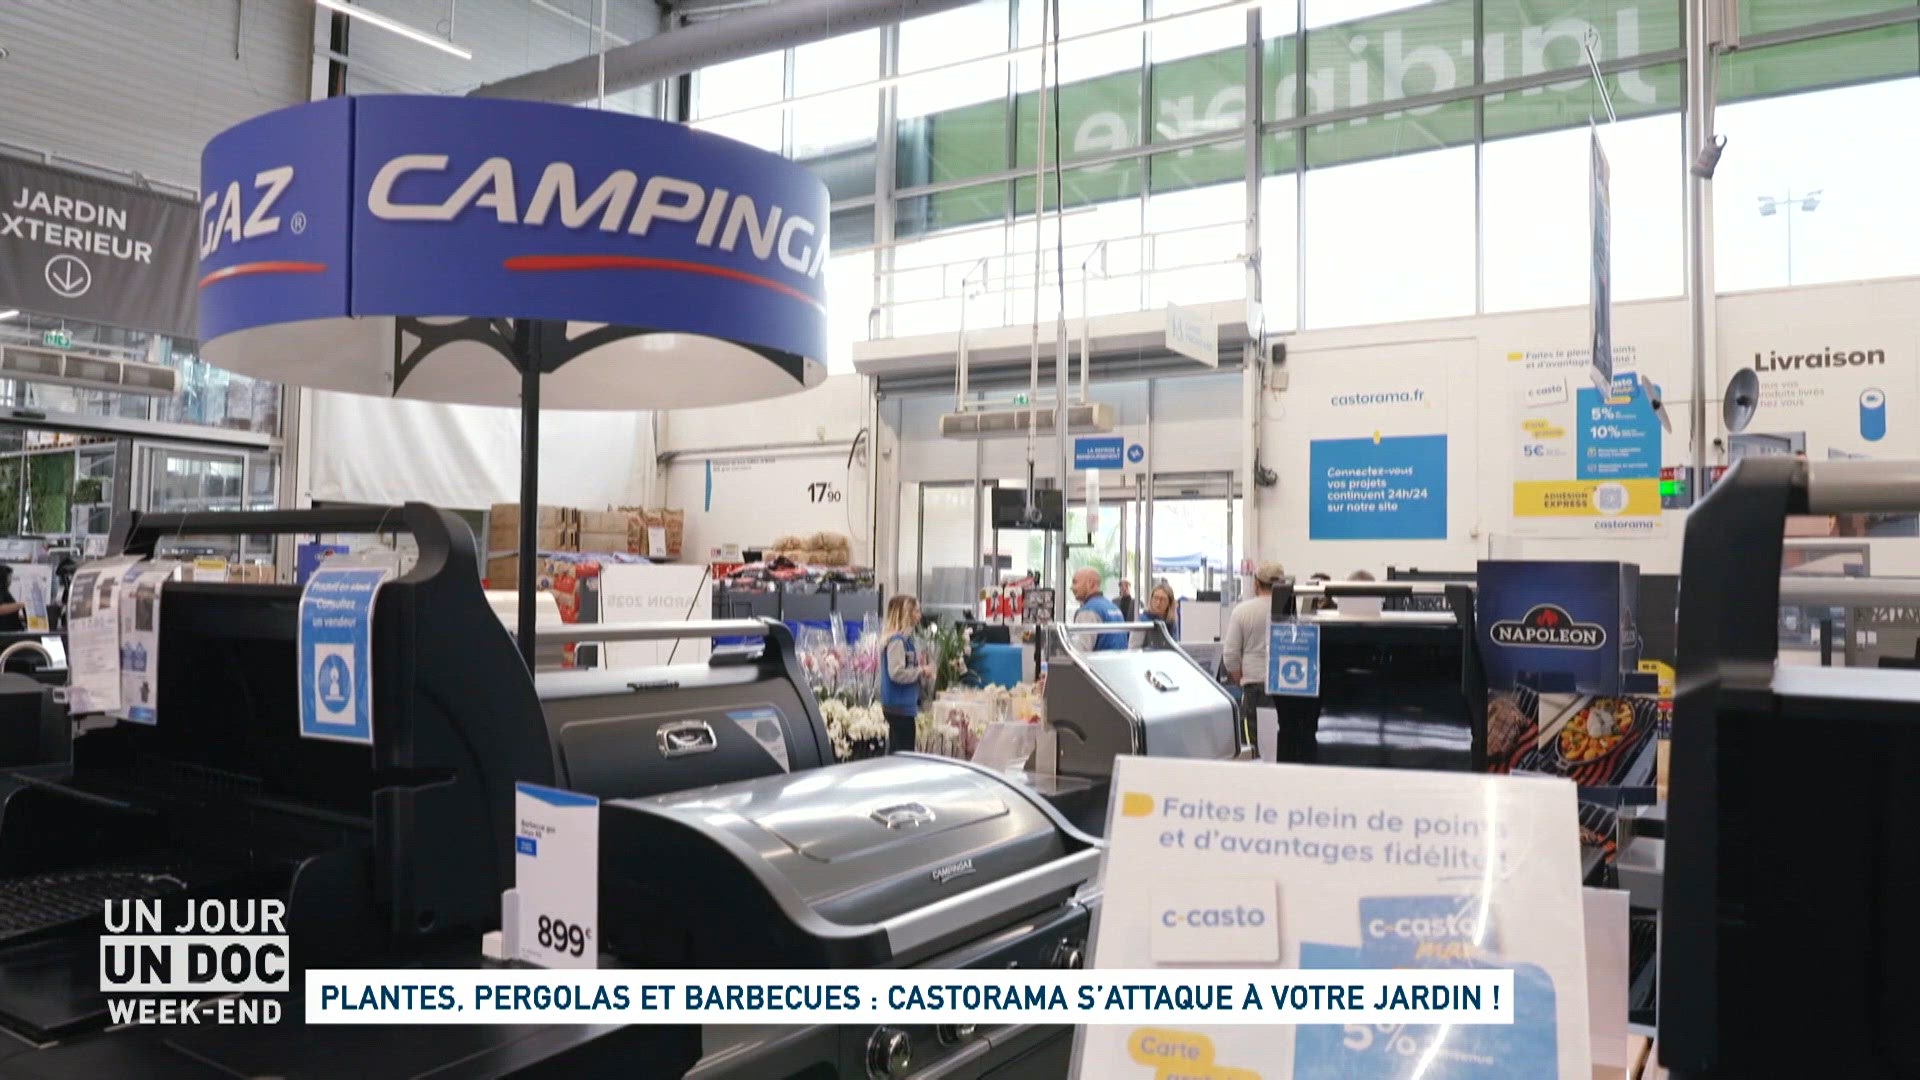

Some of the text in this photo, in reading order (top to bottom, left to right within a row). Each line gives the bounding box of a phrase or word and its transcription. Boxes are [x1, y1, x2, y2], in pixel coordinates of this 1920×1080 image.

[13, 187, 127, 231] JARDIN
[200, 166, 294, 261] GAZ
[1755, 347, 1886, 371] Livraison
[1331, 389, 1424, 406] castorama.fr
[1591, 408, 1614, 420] 5%
[1590, 425, 1621, 439] 10%
[1524, 445, 1545, 457] 5€
[1327, 466, 1414, 478] Connectez-vous
[1328, 478, 1387, 491] vos projets
[1328, 488, 1428, 501] continuent 24h/24
[1328, 501, 1398, 512] sur notre site
[1544, 500, 1588, 509] EXPRESS
[1594, 519, 1654, 531] castorama
[1498, 627, 1598, 645] NAPOLEON
[1164, 797, 1246, 823] Faites
[1256, 803, 1278, 825] le
[1288, 806, 1357, 832] plein
[1367, 810, 1403, 832] de
[1159, 830, 1185, 848] et
[1194, 829, 1374, 866] d'avantages
[1140, 1035, 1201, 1061] Carte
